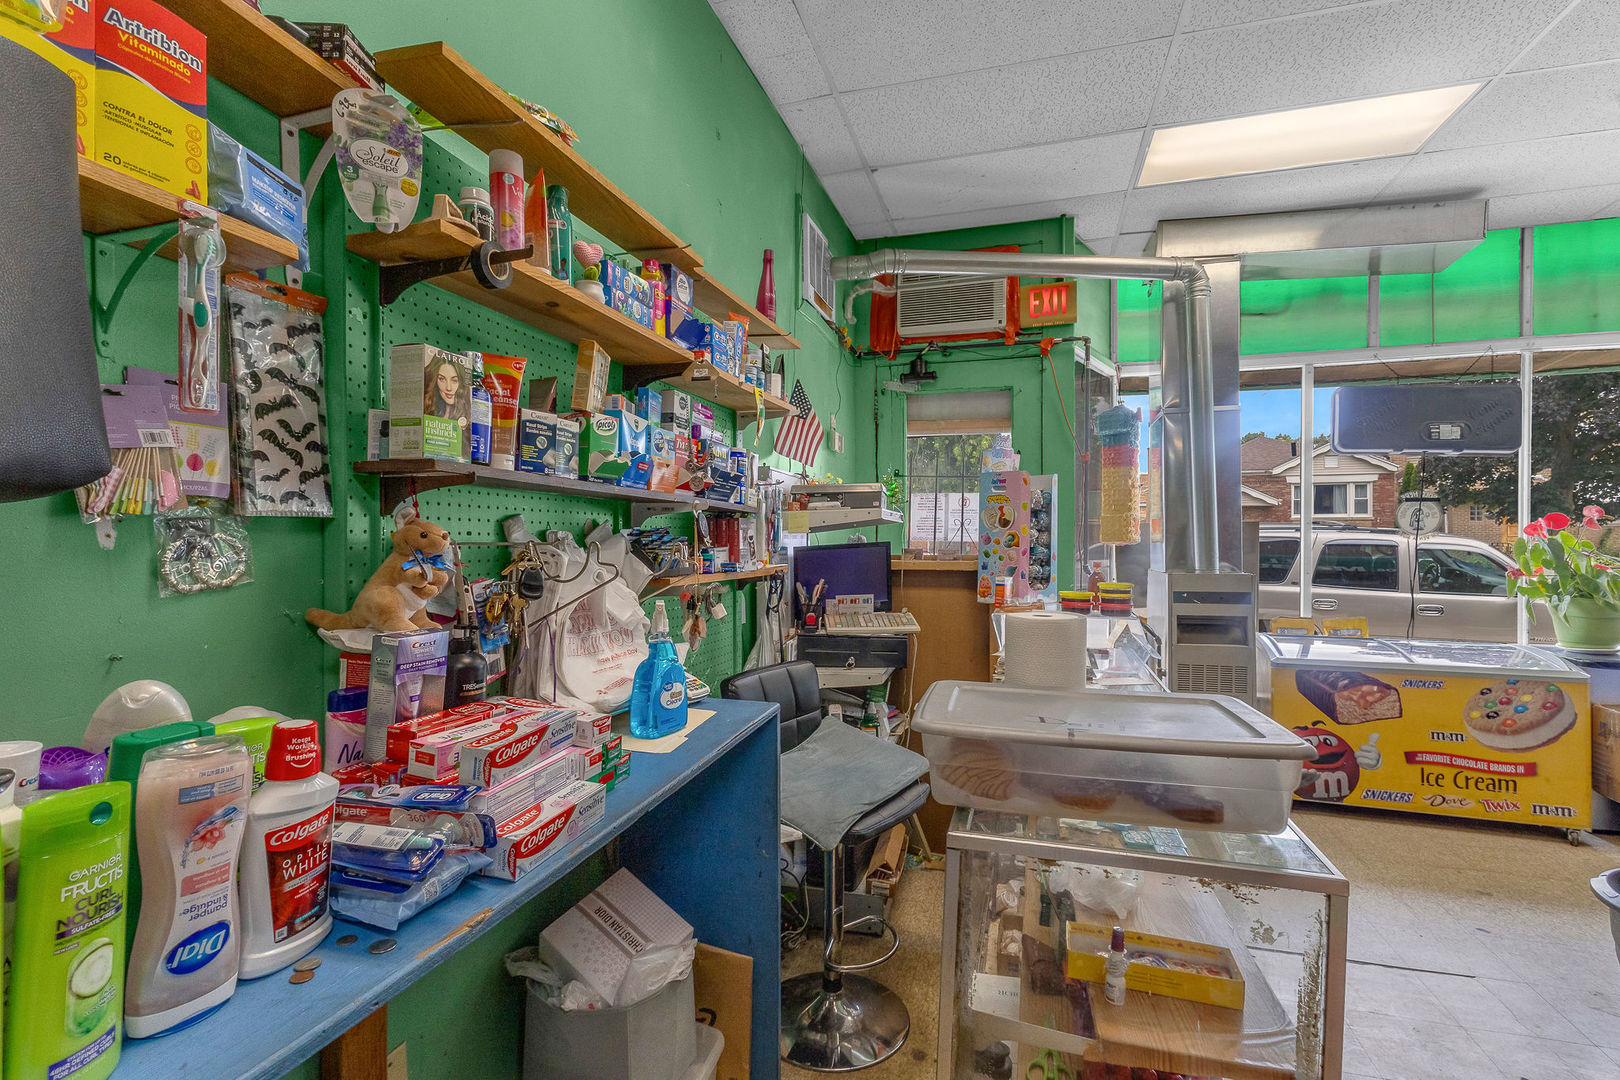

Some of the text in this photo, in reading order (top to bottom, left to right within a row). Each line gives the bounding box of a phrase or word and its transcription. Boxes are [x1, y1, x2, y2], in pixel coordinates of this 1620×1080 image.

[103, 7, 202, 73] Artribion
[118, 30, 191, 76] Vitaminado
[103, 101, 173, 135] CONTRA EL DOLOR
[103, 152, 122, 166] 20
[355, 146, 400, 168] Soleil
[362, 158, 399, 174] escape
[1029, 285, 1070, 318] EXIT
[427, 347, 472, 367] CLAIROL
[425, 419, 453, 433] natural
[411, 640, 437, 649] Crest
[426, 657, 445, 665] REMOVER
[1402, 679, 1444, 689] SNICKERS
[393, 713, 441, 728] Colgate
[548, 721, 577, 739] Sensitive
[291, 736, 311, 744] Keeps
[472, 727, 514, 747] Colgate
[286, 752, 317, 762] Brushing
[337, 741, 364, 765] Na
[495, 734, 538, 763] Colgate
[1423, 753, 1524, 773] FAVORITE CHOCOLATE BRANDS IN
[1420, 767, 1517, 794] Ice Cream
[576, 796, 605, 818] Sensitive
[1362, 789, 1413, 803] SNICKERS
[1422, 794, 1474, 808] Dove
[1480, 799, 1521, 812] Twix
[335, 806, 368, 816] olgate
[496, 808, 539, 836] Colgate
[270, 813, 329, 846] Colgate
[520, 815, 566, 853] Colgate
[282, 836, 330, 868] OPTIC
[69, 853, 121, 881] GARNIER
[282, 848, 329, 881] WHITE
[61, 864, 123, 902] FRUCTIS
[75, 886, 116, 911] CURL
[182, 893, 228, 916] & indulge
[57, 889, 123, 931] NOURISH
[189, 901, 228, 922] pamper
[71, 909, 116, 934] SULFATE-FREE
[594, 906, 643, 953] CHRISTIAN DIOR
[170, 929, 226, 969] Dial
